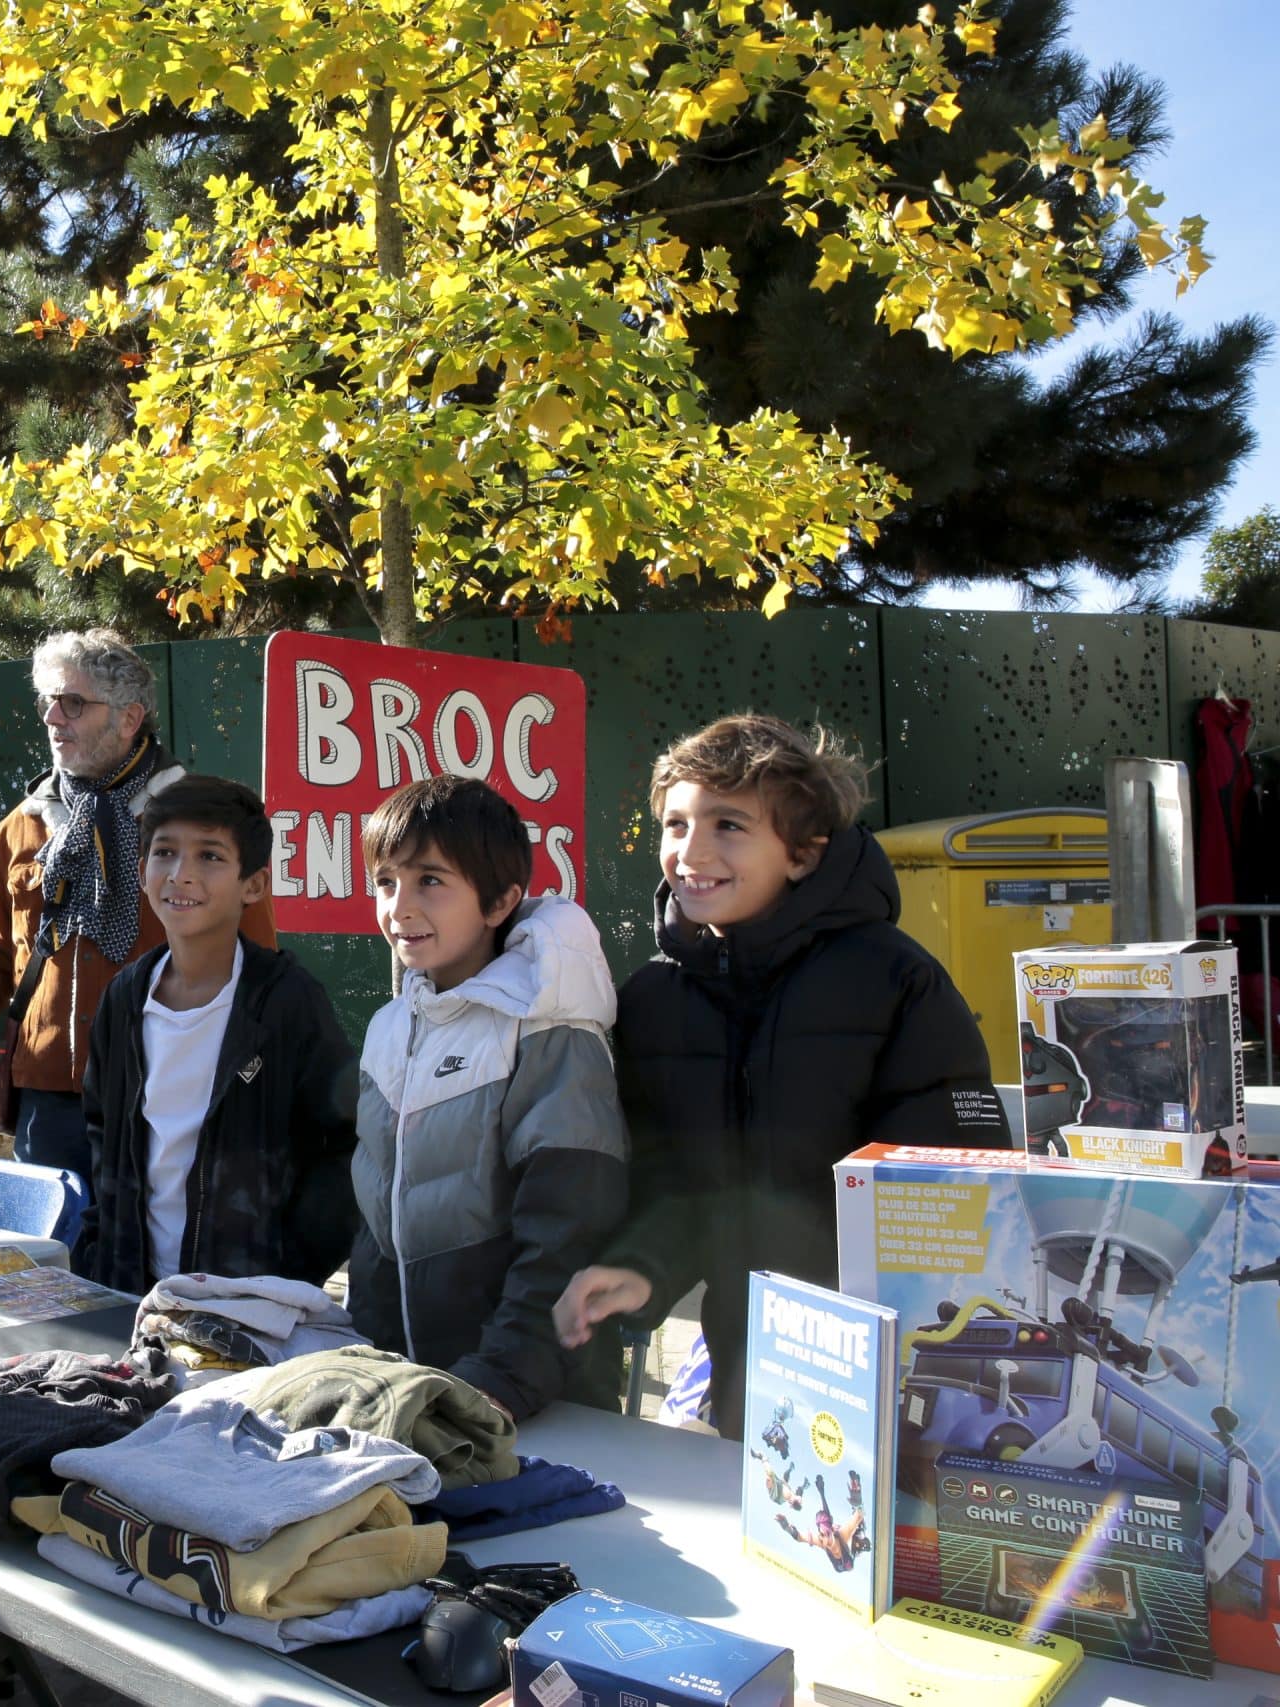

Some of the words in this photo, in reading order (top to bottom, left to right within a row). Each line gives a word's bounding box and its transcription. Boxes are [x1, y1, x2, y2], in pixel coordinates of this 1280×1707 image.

[295, 660, 558, 802] BROC
[1023, 963, 1075, 989] POP!
[1077, 969, 1139, 986] FORTNITE
[1142, 969, 1170, 985] 426
[1230, 975, 1241, 1045] BLACK
[441, 1055, 466, 1069] NIKE
[952, 1091, 981, 1100] FUTURE
[1233, 1049, 1245, 1126] KNIGHT
[954, 1101, 983, 1109] BEGINS
[956, 1110, 981, 1119] TODAY
[1082, 1136, 1119, 1151] BLACK
[1123, 1138, 1167, 1154] KNIGHT
[846, 1175, 865, 1188] 8+
[878, 1185, 904, 1196] OVER
[924, 1188, 940, 1198] CM
[878, 1199, 903, 1209] PLUS
[906, 1200, 919, 1210] DE
[922, 1201, 936, 1211] 33
[938, 1202, 957, 1213] CM
[879, 1210, 894, 1220] DE
[895, 1211, 939, 1223] HAUTEUR
[879, 1225, 904, 1235] ALTO
[940, 1229, 954, 1239] 33
[907, 1241, 922, 1251] 33
[924, 1242, 942, 1252] CM
[899, 1254, 916, 1264] CM
[918, 1255, 932, 1265] DE
[762, 1288, 869, 1370] FORTNITE
[775, 1337, 811, 1363] BATTLE
[812, 1351, 853, 1379] ROYALE
[949, 1454, 1057, 1474] SMARTPHONE
[944, 1459, 989, 1471] GAME
[992, 1465, 1102, 1486] CONTROLLER
[1026, 1492, 1183, 1532] SMARTPHONE
[966, 1505, 1024, 1526] GAME
[1031, 1514, 1184, 1553] CONTROLLER
[905, 1606, 1058, 1650] CLASSROOM
[920, 1603, 1051, 1640] ASSASSINATION
[668, 1676, 690, 1687] Box
[690, 1682, 723, 1696] Game
